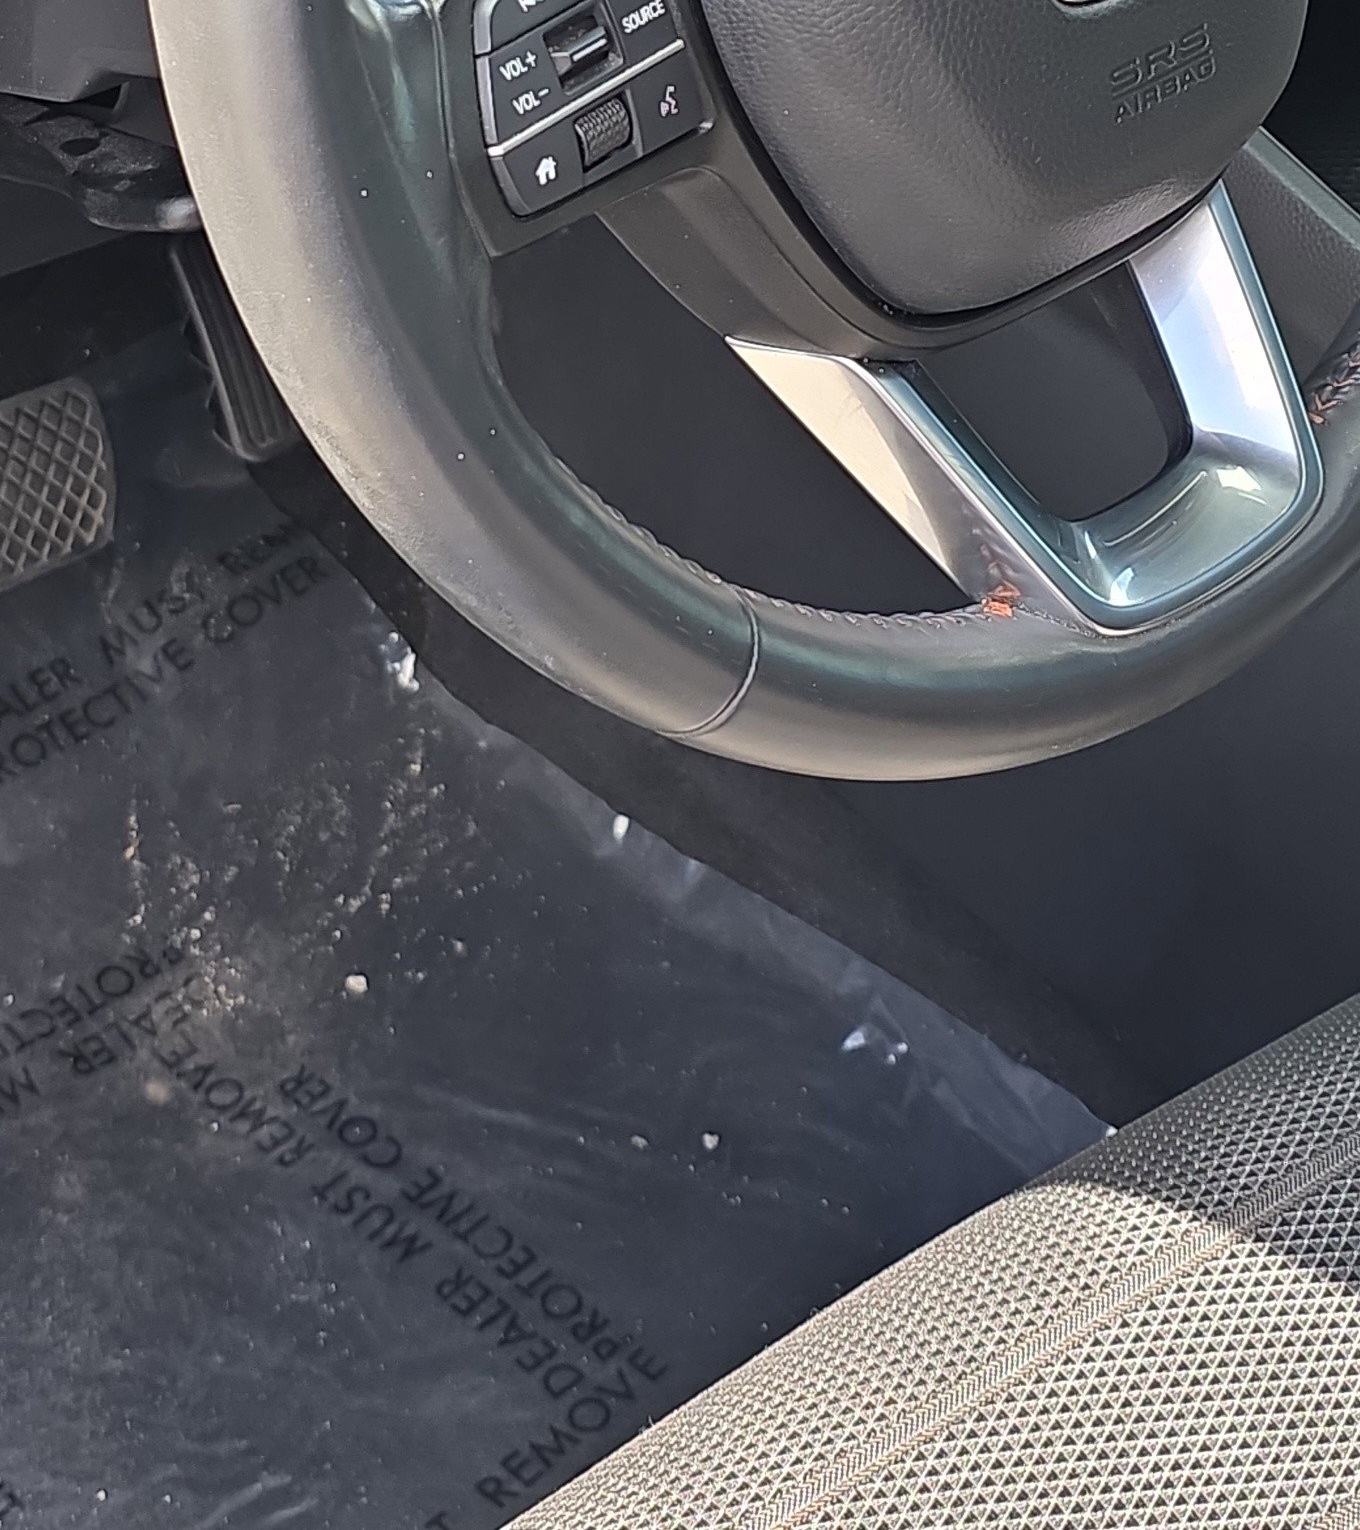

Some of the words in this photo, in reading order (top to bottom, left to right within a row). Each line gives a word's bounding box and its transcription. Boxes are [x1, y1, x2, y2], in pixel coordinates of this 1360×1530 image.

[1110, 22, 1214, 101] SRS
[1114, 47, 1217, 126] AIRBAG
[97, 568, 207, 669] MUST
[201, 553, 330, 645] COVER
[149, 1030, 316, 1169] REMOVE
[276, 1062, 404, 1170] COVER
[310, 1172, 434, 1265] MUST
[401, 1166, 631, 1365] PROTECTIVE
[433, 1266, 584, 1401] DEALER
[474, 1346, 669, 1509] REMOVE
